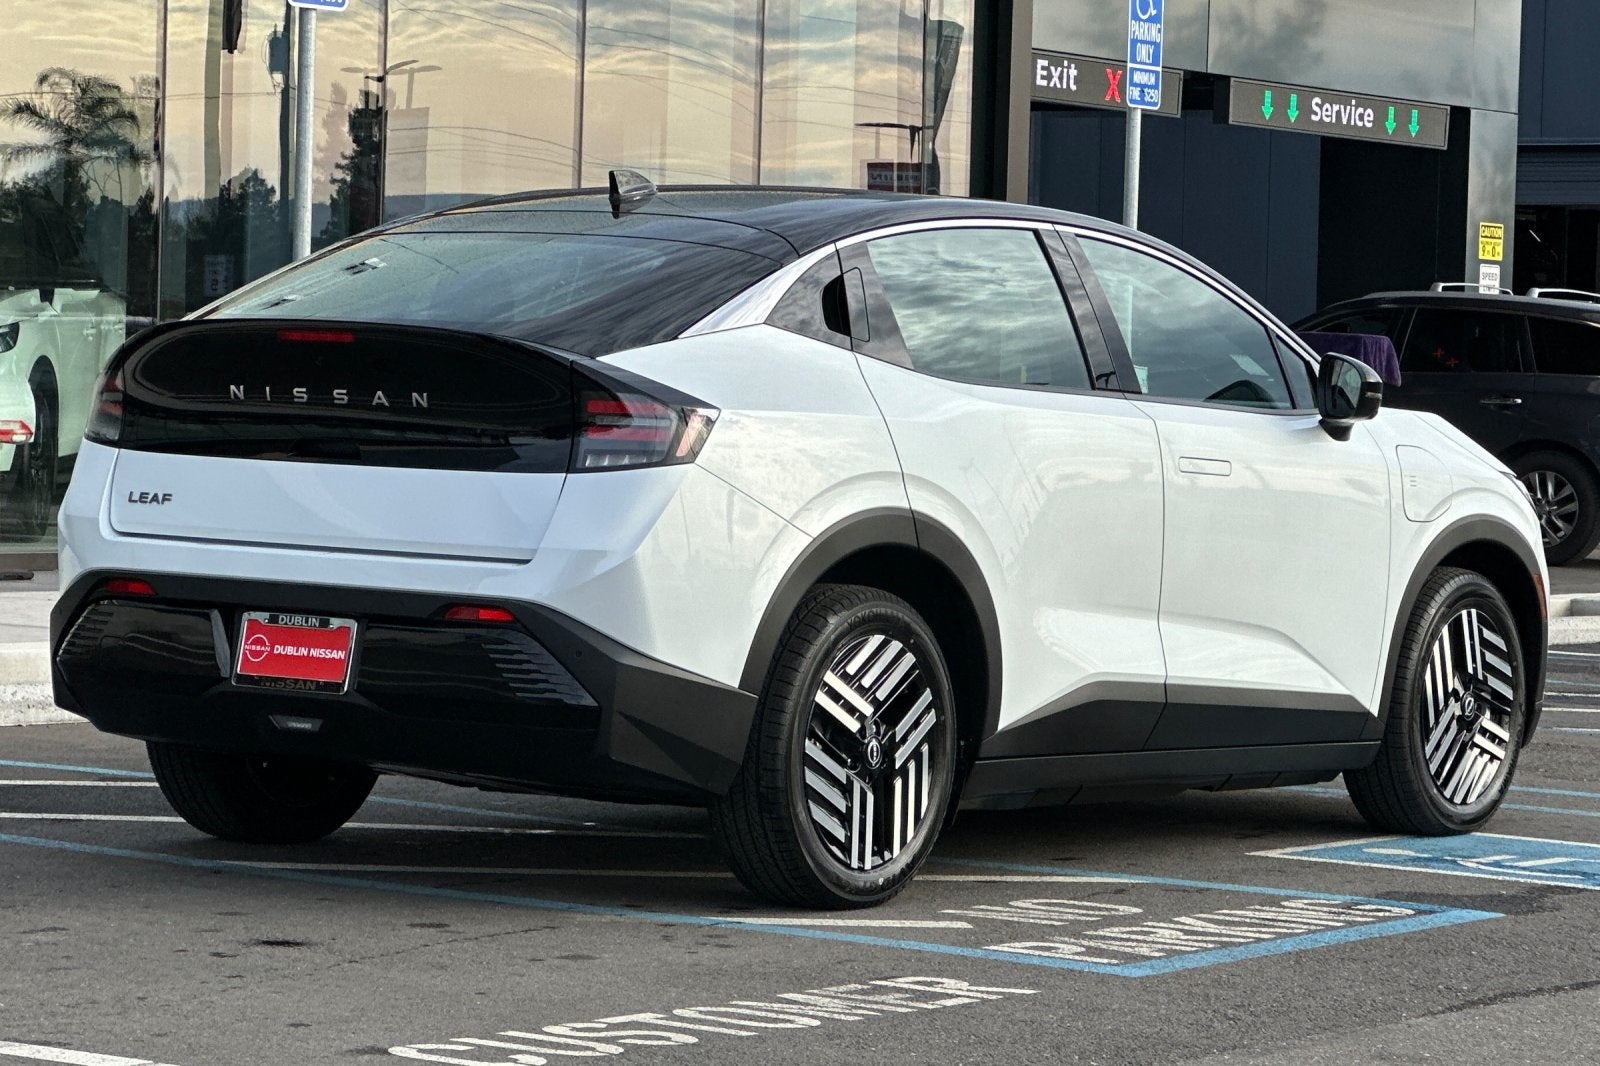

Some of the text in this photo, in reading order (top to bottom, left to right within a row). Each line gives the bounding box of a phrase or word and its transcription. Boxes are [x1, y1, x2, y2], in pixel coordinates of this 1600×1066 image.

[1131, 20, 1161, 43] PARKING
[1136, 42, 1155, 63] ONLY
[1035, 58, 1078, 91] Exit
[1132, 69, 1156, 86] MINIMUM
[1129, 86, 1159, 103] FINE $250
[1311, 97, 1374, 128] Service
[1481, 272, 1498, 281] SPEED
[229, 384, 428, 408] NISSAN
[128, 491, 173, 505] LEAF
[278, 615, 320, 627] DUBLIN
[245, 644, 270, 652] NISSAN
[273, 645, 346, 660] DUBLIN NISSAN
[938, 899, 1143, 926] NO
[982, 899, 1415, 965] PARKING
[388, 976, 1042, 1066] CUSTOMER
